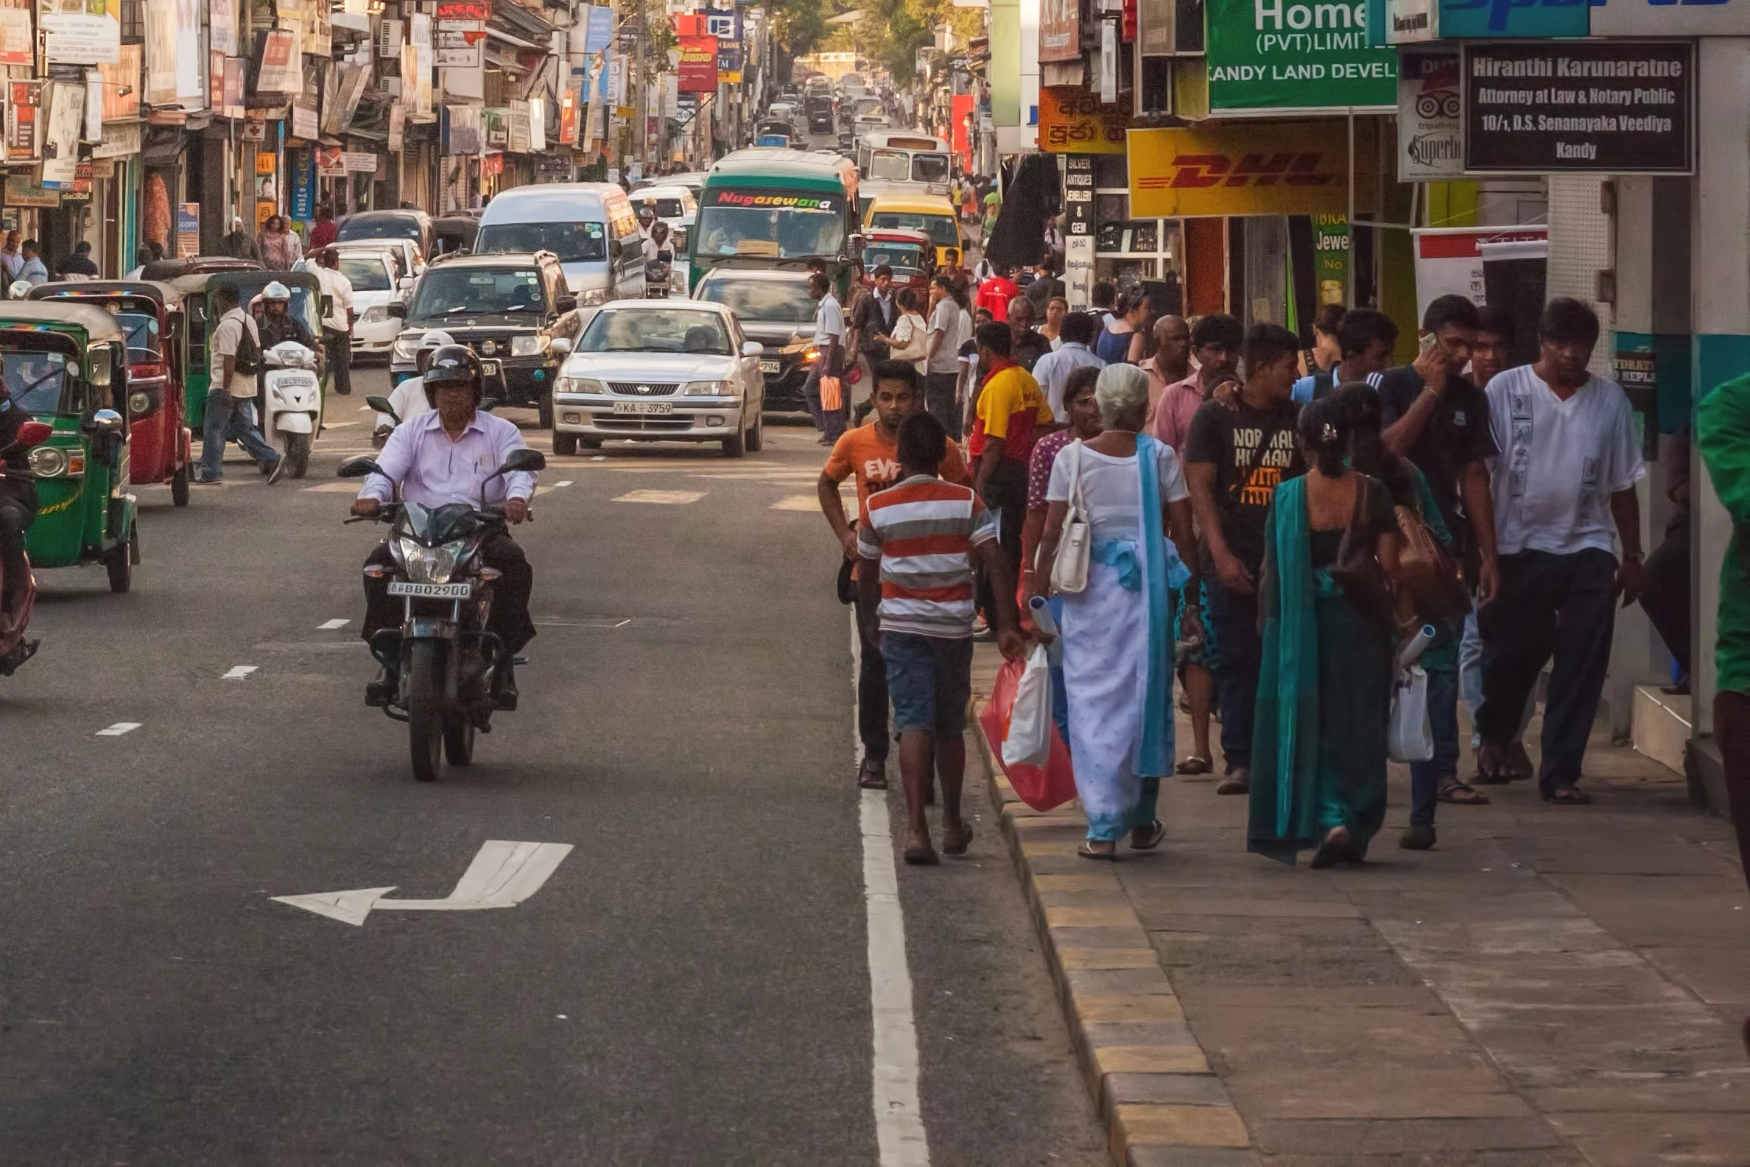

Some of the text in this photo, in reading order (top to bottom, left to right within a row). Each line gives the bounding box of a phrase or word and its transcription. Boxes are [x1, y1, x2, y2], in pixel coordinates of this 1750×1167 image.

[1272, 63, 1326, 81] LAND
[1473, 56, 1682, 79] Hiranthi Karunaratne
[1478, 86, 1676, 108] Attorney at Law & Notary Public
[1513, 114, 1537, 132] D.S.
[1538, 113, 1617, 136] Senanayaka
[1619, 112, 1673, 136] Veediya
[1556, 140, 1597, 162] Kandy
[1068, 159, 1091, 170] SILVER
[1169, 153, 1334, 189] DHL
[1067, 175, 1092, 186] ANTIQUES
[717, 191, 832, 210] Nugasewana
[1066, 190, 1092, 202] JEWELLERY
[1076, 205, 1083, 218] &
[1071, 222, 1087, 234] GEM
[1316, 231, 1350, 251] Jewe
[647, 403, 671, 413] 3759
